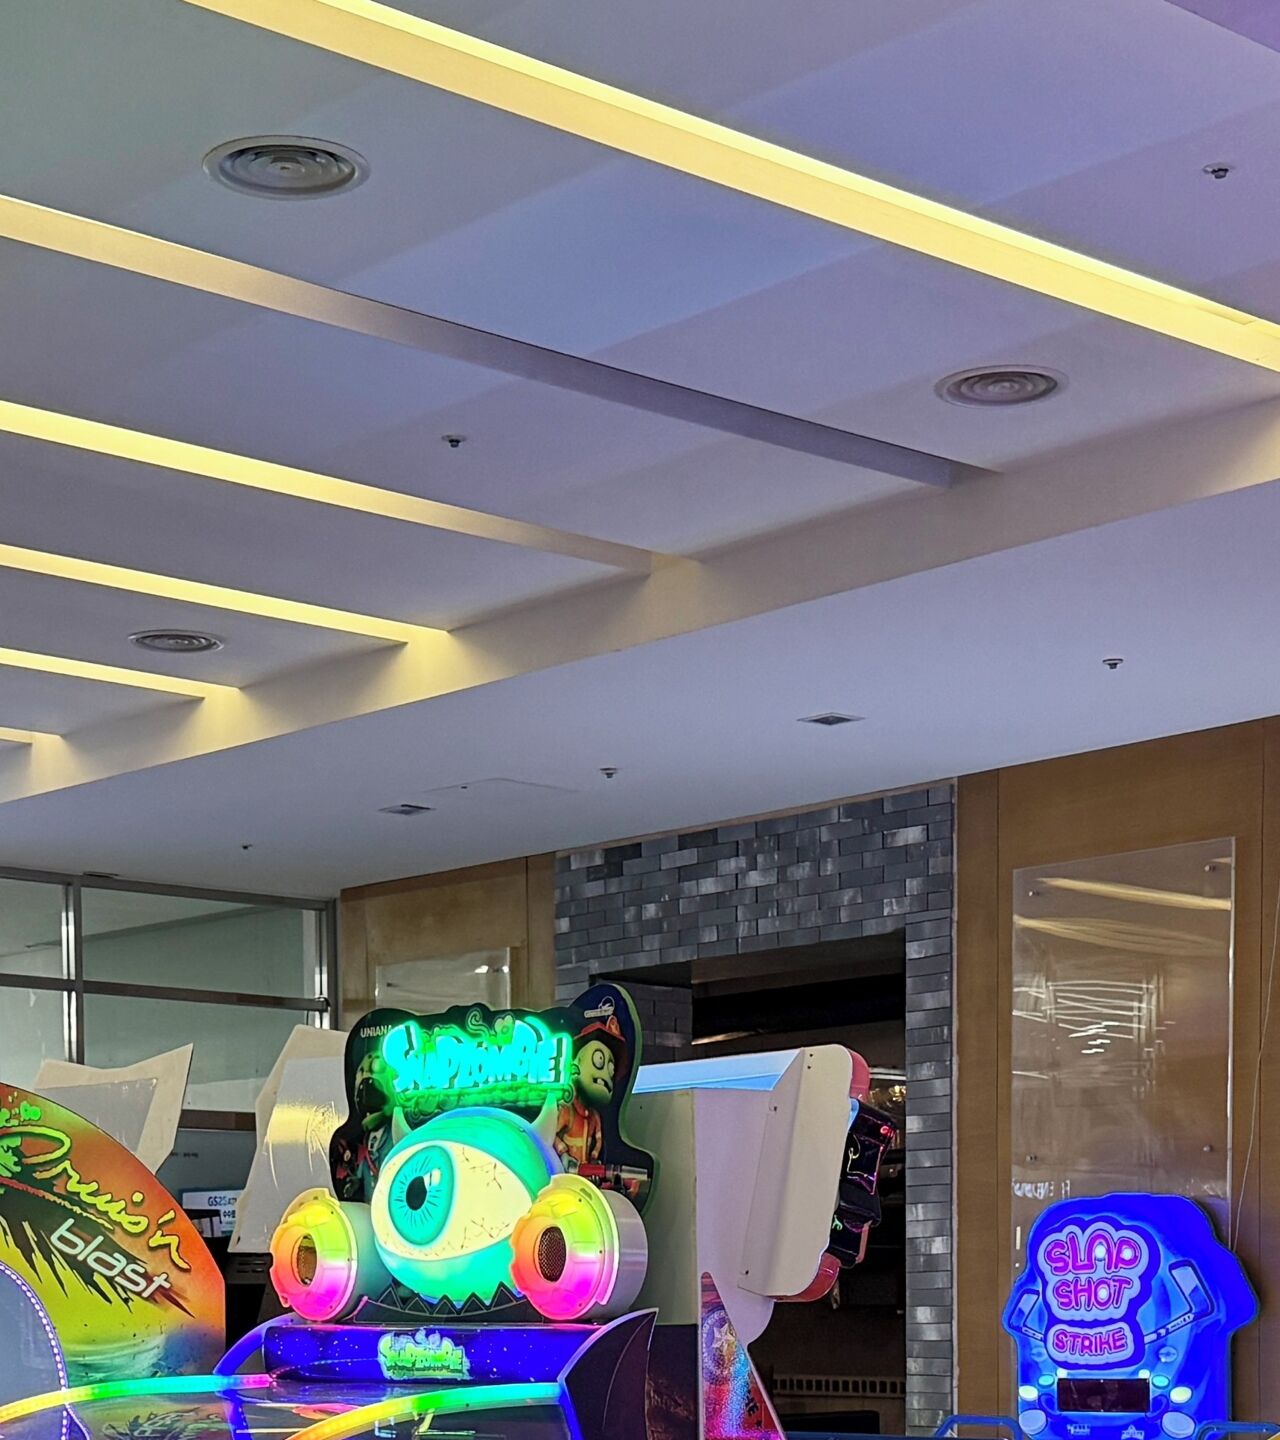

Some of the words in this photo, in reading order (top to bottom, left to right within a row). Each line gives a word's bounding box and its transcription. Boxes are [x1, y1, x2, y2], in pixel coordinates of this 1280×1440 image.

[50, 1218, 173, 1306] blast
[1044, 1229, 1140, 1275] SLAP
[1052, 1277, 1132, 1311] SHOT
[1053, 1328, 1128, 1356] STRIKE
